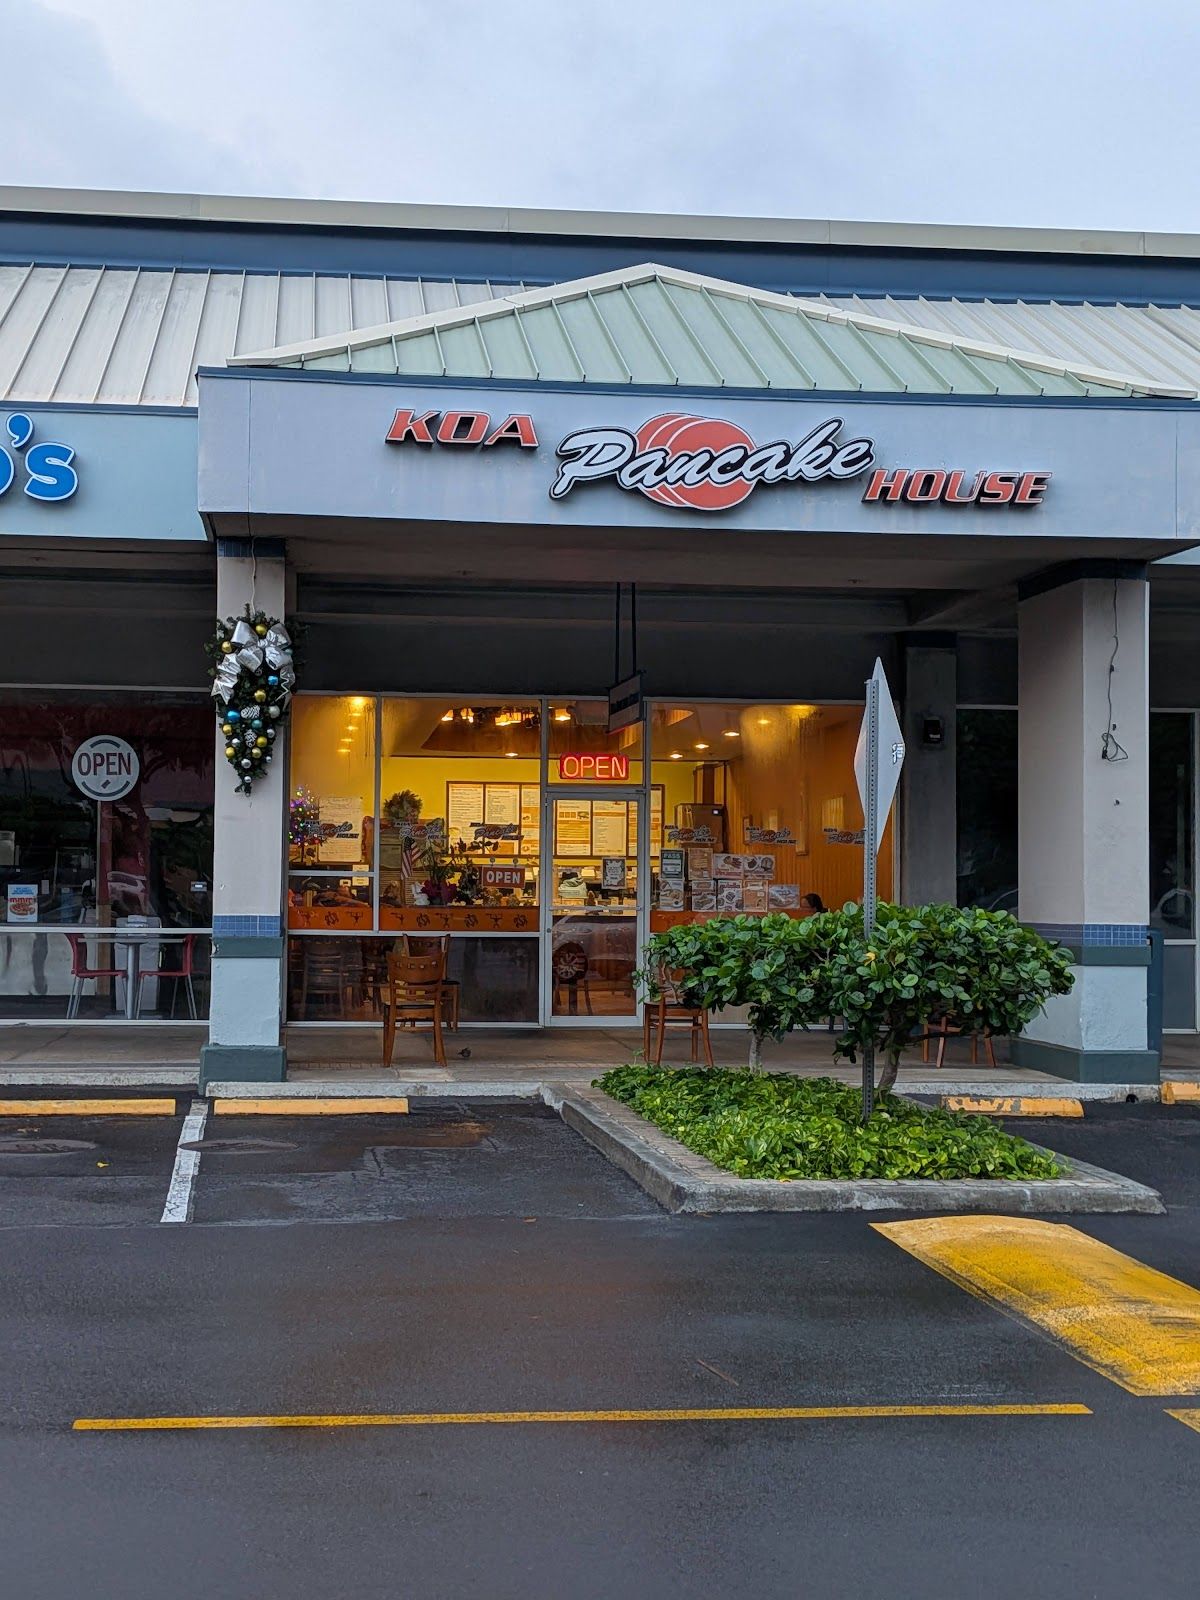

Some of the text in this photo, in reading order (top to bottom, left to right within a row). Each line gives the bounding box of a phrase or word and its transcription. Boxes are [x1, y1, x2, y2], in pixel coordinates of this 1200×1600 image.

[385, 408, 1052, 504] KOA Pancake HOUSE
[77, 752, 132, 776] OPEN
[563, 756, 626, 777] OPEN
[486, 870, 521, 884] OPEN
